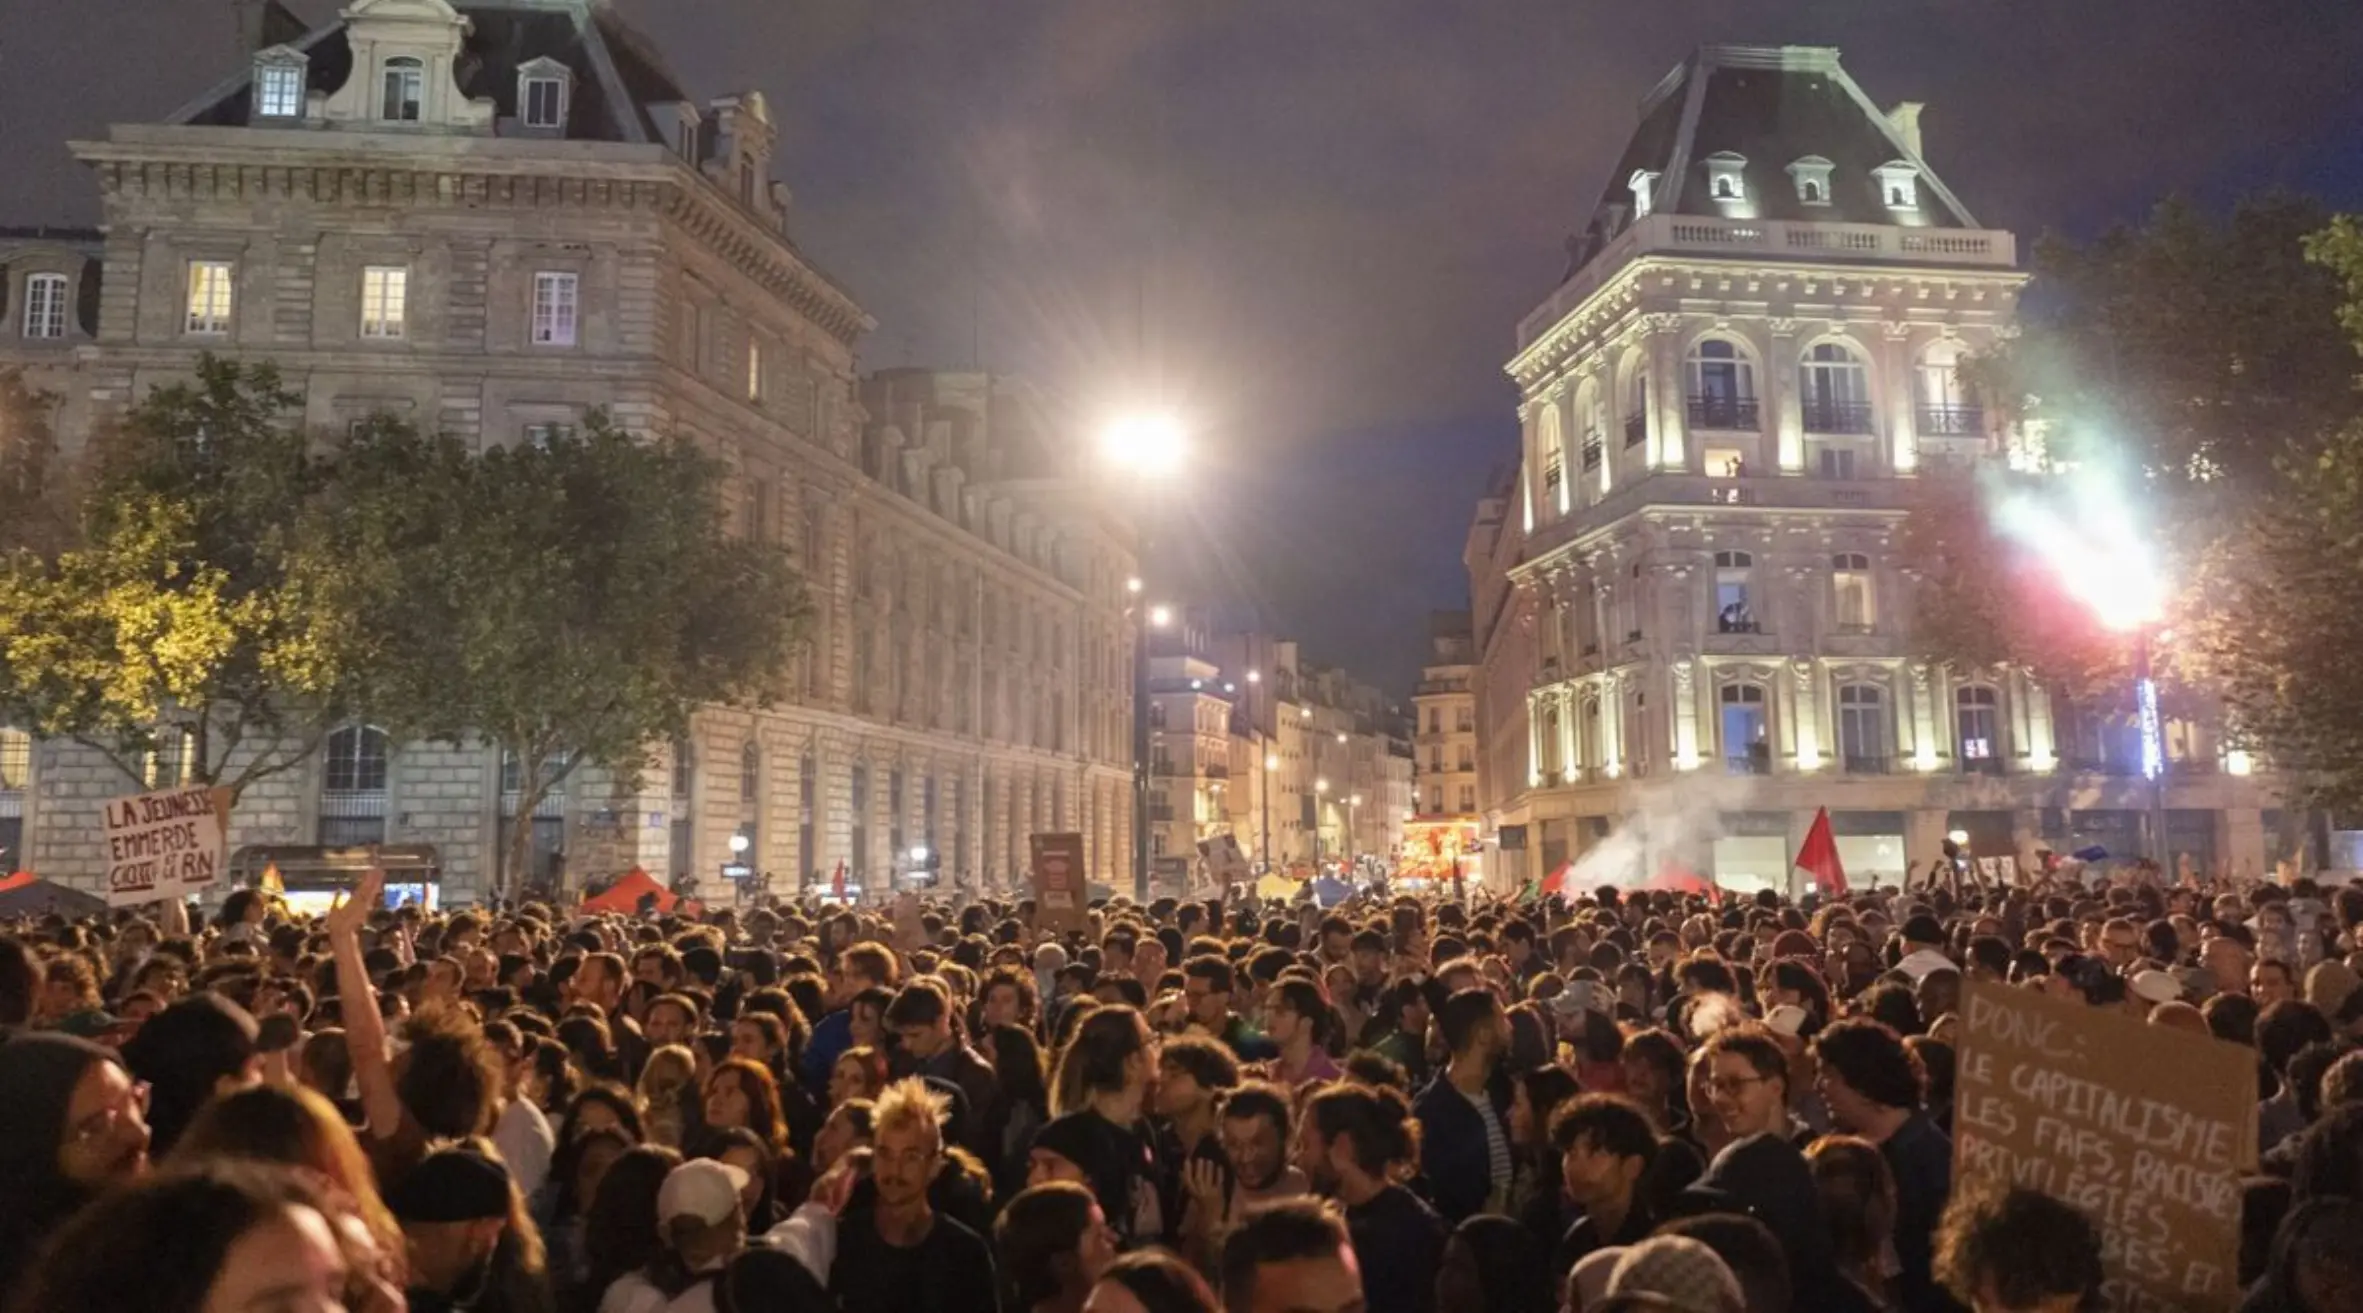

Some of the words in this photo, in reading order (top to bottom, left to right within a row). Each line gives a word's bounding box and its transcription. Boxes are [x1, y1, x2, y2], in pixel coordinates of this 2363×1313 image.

[107, 801, 137, 829] LA
[139, 788, 215, 824] JEUNESSE
[110, 822, 200, 861] EMMERDE
[182, 850, 213, 877] RN
[1961, 1046, 1993, 1086] LE
[2009, 1063, 2232, 1165] CAPITALISME
[1961, 1092, 2017, 1137] LES
